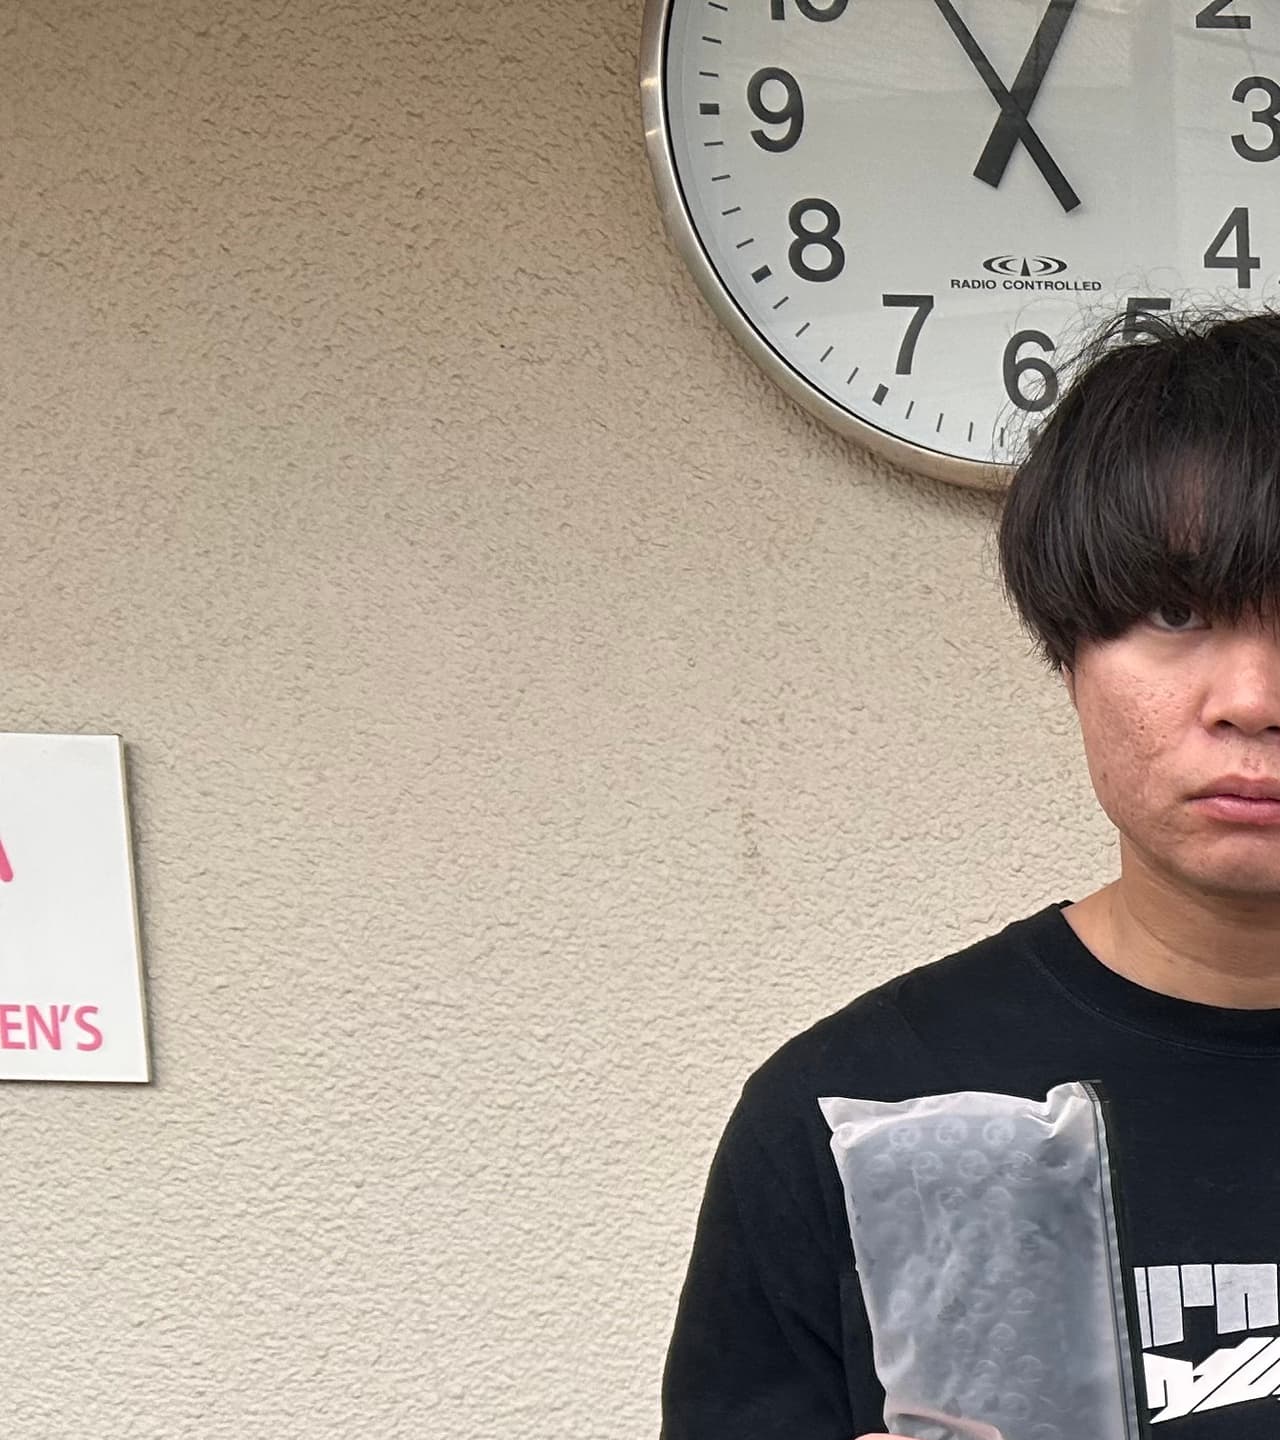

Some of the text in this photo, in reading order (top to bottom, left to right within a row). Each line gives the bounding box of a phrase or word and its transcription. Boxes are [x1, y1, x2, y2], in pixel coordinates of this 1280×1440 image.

[747, 67, 804, 153] 9
[787, 197, 846, 283] 8
[1203, 206, 1261, 289] 4
[950, 279, 1102, 291] RADIO CONTROLLED
[882, 294, 934, 376] 7
[1002, 329, 1059, 412] 6
